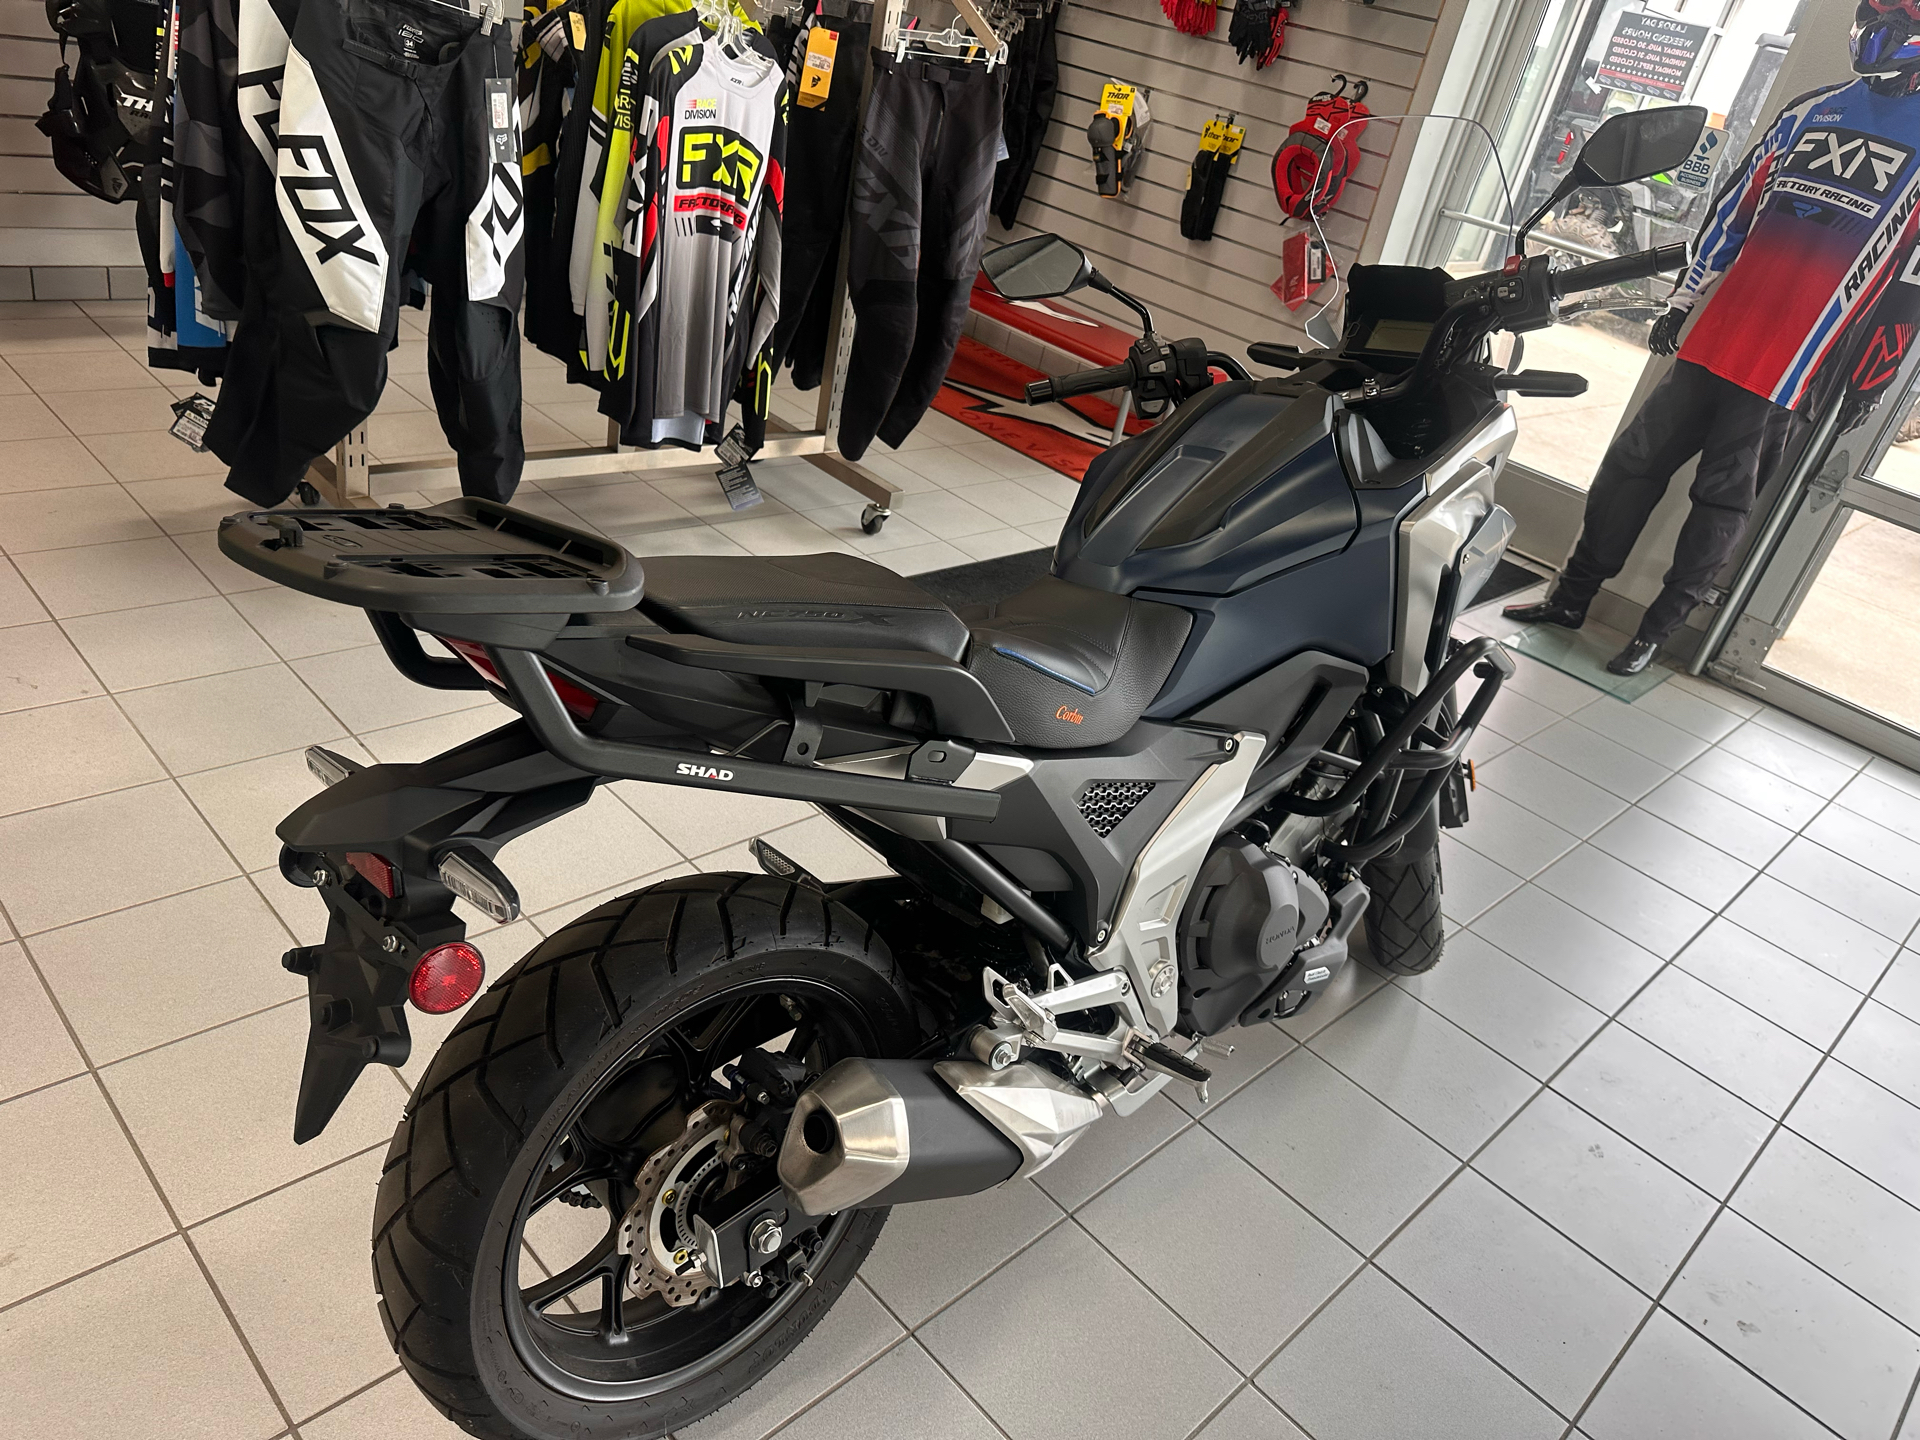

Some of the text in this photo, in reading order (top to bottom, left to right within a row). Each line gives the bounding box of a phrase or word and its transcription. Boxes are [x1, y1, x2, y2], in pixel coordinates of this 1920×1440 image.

[696, 99, 717, 108] RACE
[1107, 92, 1130, 100] THOR
[684, 109, 717, 120] DIVISION
[1812, 114, 1843, 123] DIVISION
[1207, 131, 1222, 141] thor
[682, 133, 760, 201] FXR
[1683, 160, 1710, 175] BBB
[1784, 132, 1908, 192] FXR
[278, 135, 380, 266] FOX
[1820, 189, 1874, 213] RACING
[1844, 180, 1920, 303] RACING
[1056, 705, 1084, 725] Corbin
[676, 763, 734, 781] SHAD
[1265, 925, 1296, 945] HONDA
